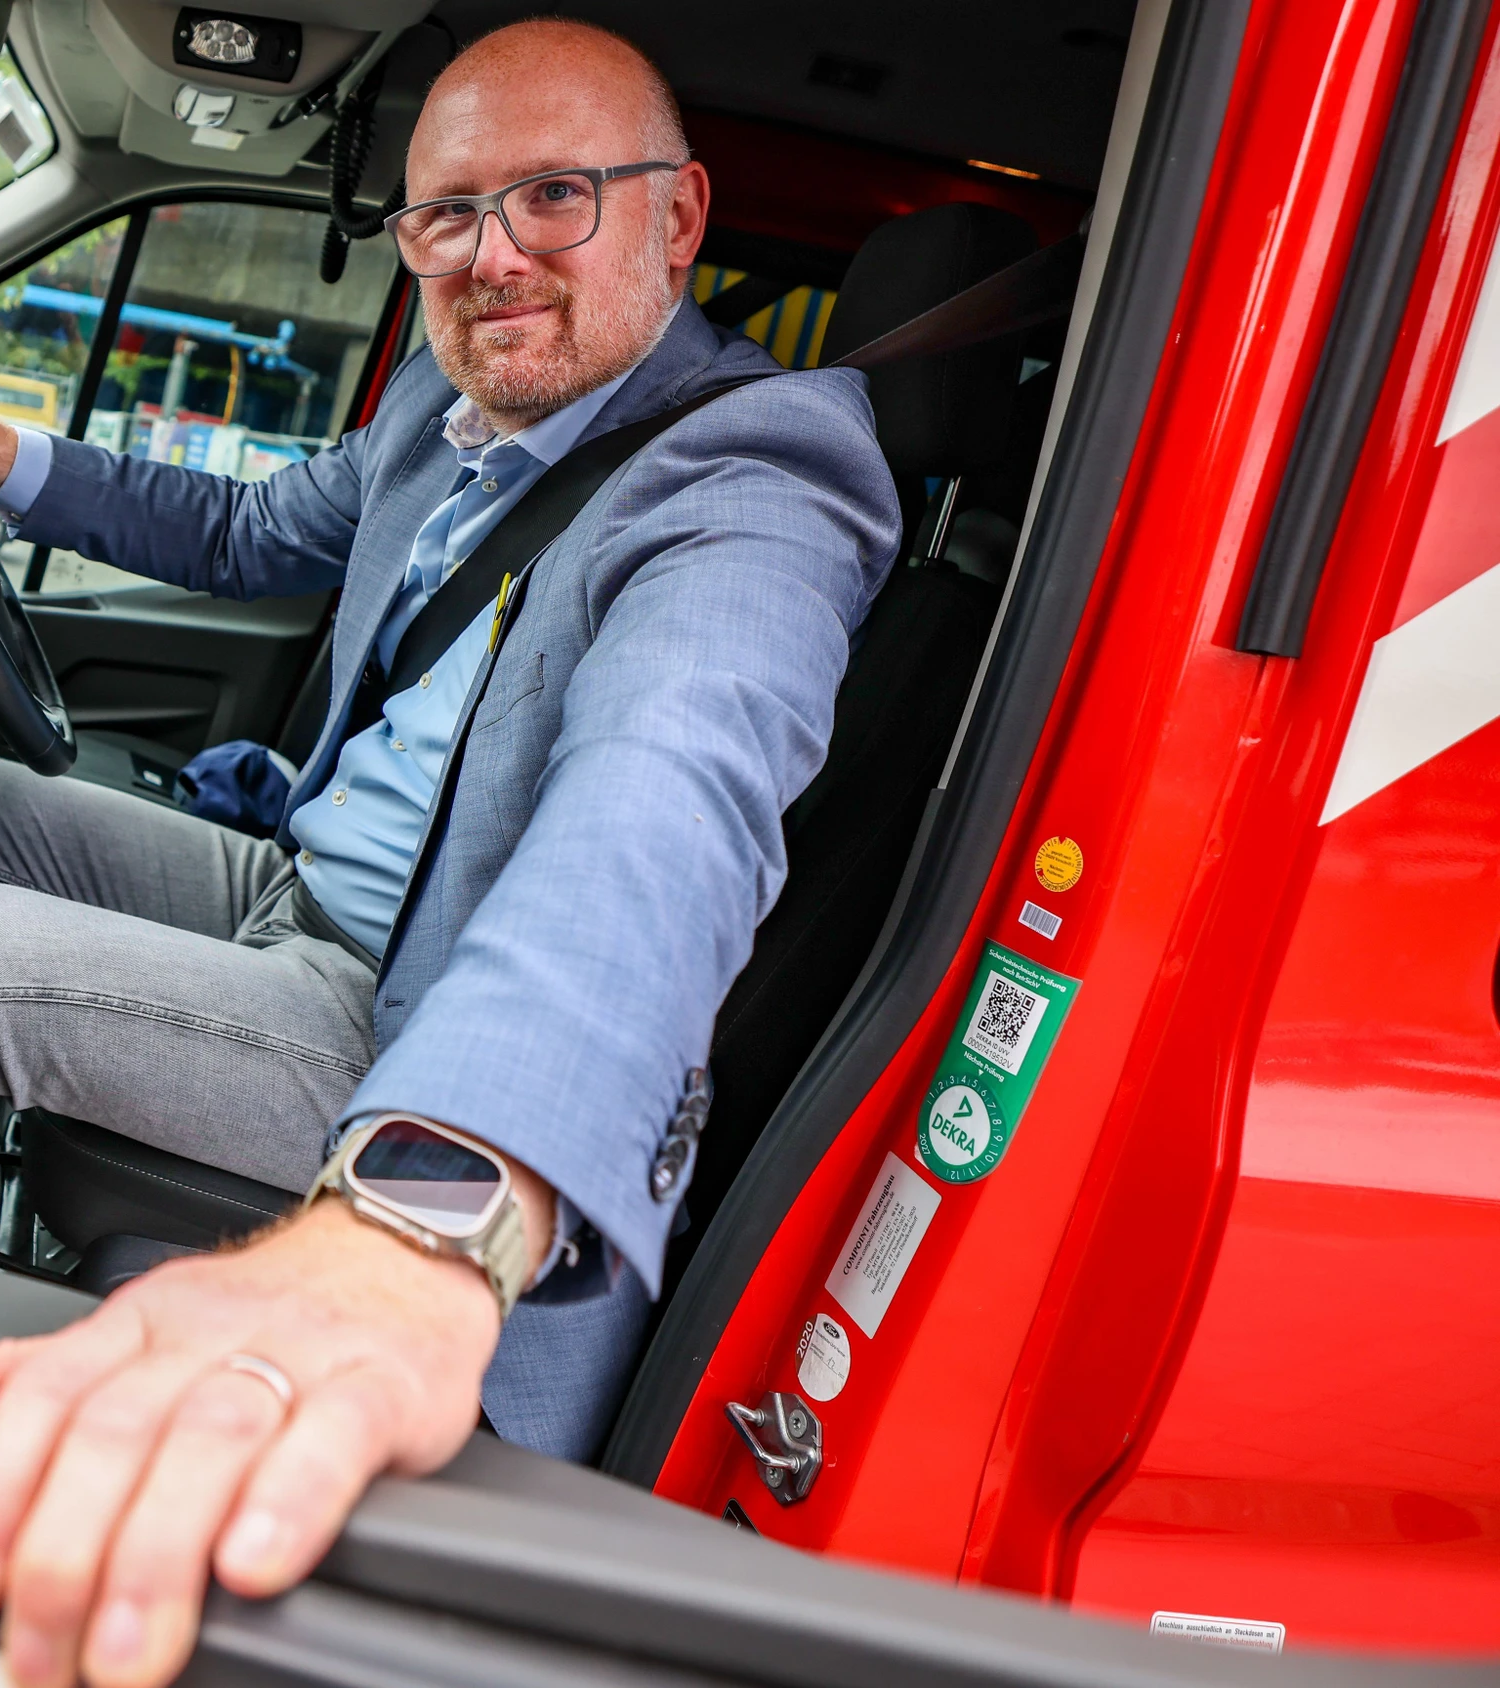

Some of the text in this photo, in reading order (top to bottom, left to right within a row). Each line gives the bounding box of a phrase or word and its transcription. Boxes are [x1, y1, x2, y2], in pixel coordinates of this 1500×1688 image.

[1002, 966, 1015, 976] nach
[1039, 975, 1067, 992] Prüfung
[984, 1064, 1004, 1082] Prüfung
[931, 1112, 975, 1156] DEKRA
[842, 1175, 894, 1275] COMPOINT Fahrzeugbau
[796, 1321, 813, 1358] 2020
[1158, 1620, 1183, 1630] Anschluss
[1186, 1623, 1222, 1633] ausschließlich
[1235, 1628, 1263, 1637] Steckdosen
